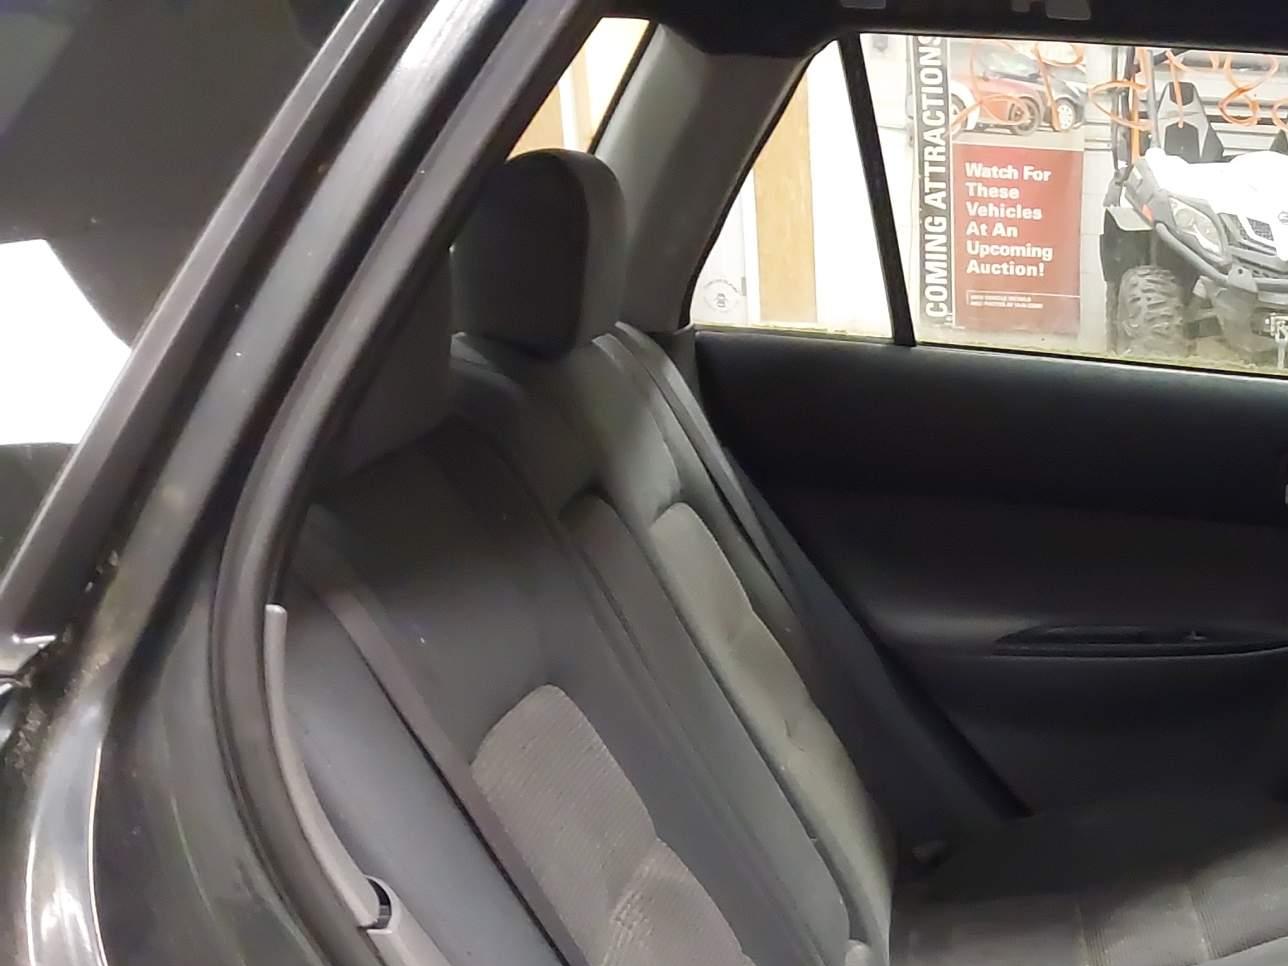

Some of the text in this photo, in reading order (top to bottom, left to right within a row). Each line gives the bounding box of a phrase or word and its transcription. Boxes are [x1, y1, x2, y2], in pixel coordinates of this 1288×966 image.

[965, 161, 1052, 182] Watch For
[965, 182, 1020, 200] These
[965, 200, 1043, 220] Vehicles
[965, 221, 1018, 238] At An
[966, 240, 1053, 261] Upcoming
[924, 215, 947, 318] COMING
[966, 260, 1044, 277] Auction!
